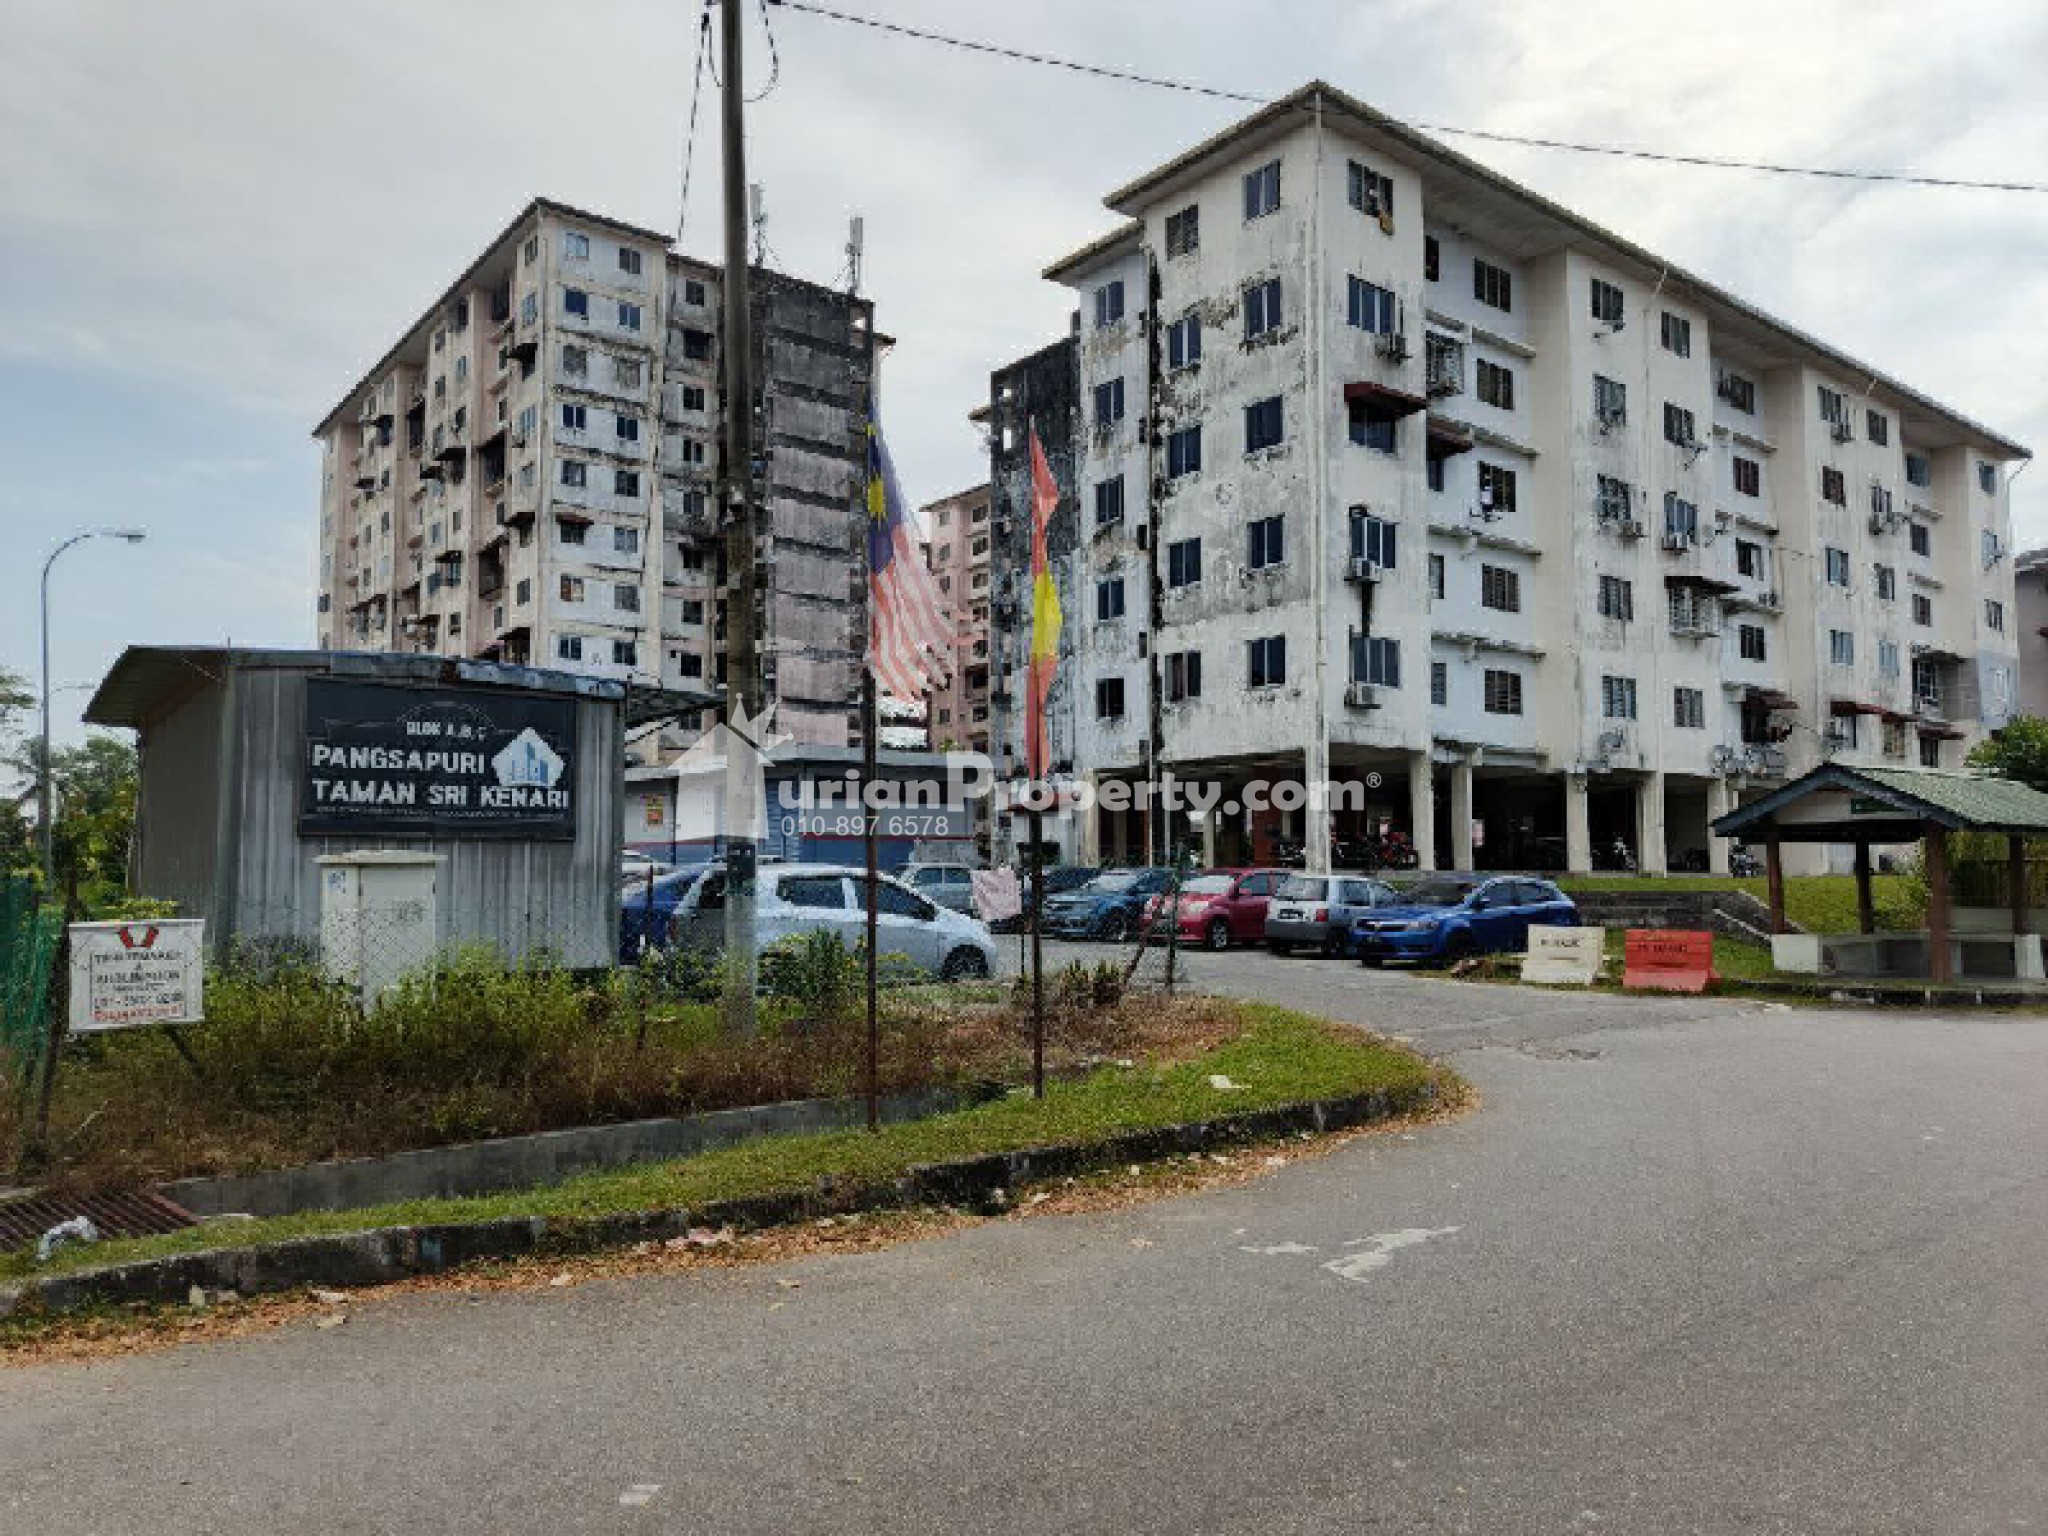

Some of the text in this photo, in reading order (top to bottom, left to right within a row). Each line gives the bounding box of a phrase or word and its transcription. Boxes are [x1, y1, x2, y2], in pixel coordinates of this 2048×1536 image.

[312, 744, 486, 774] PANGSAPURI
[311, 780, 569, 808] TAMAN SRI KENARI
